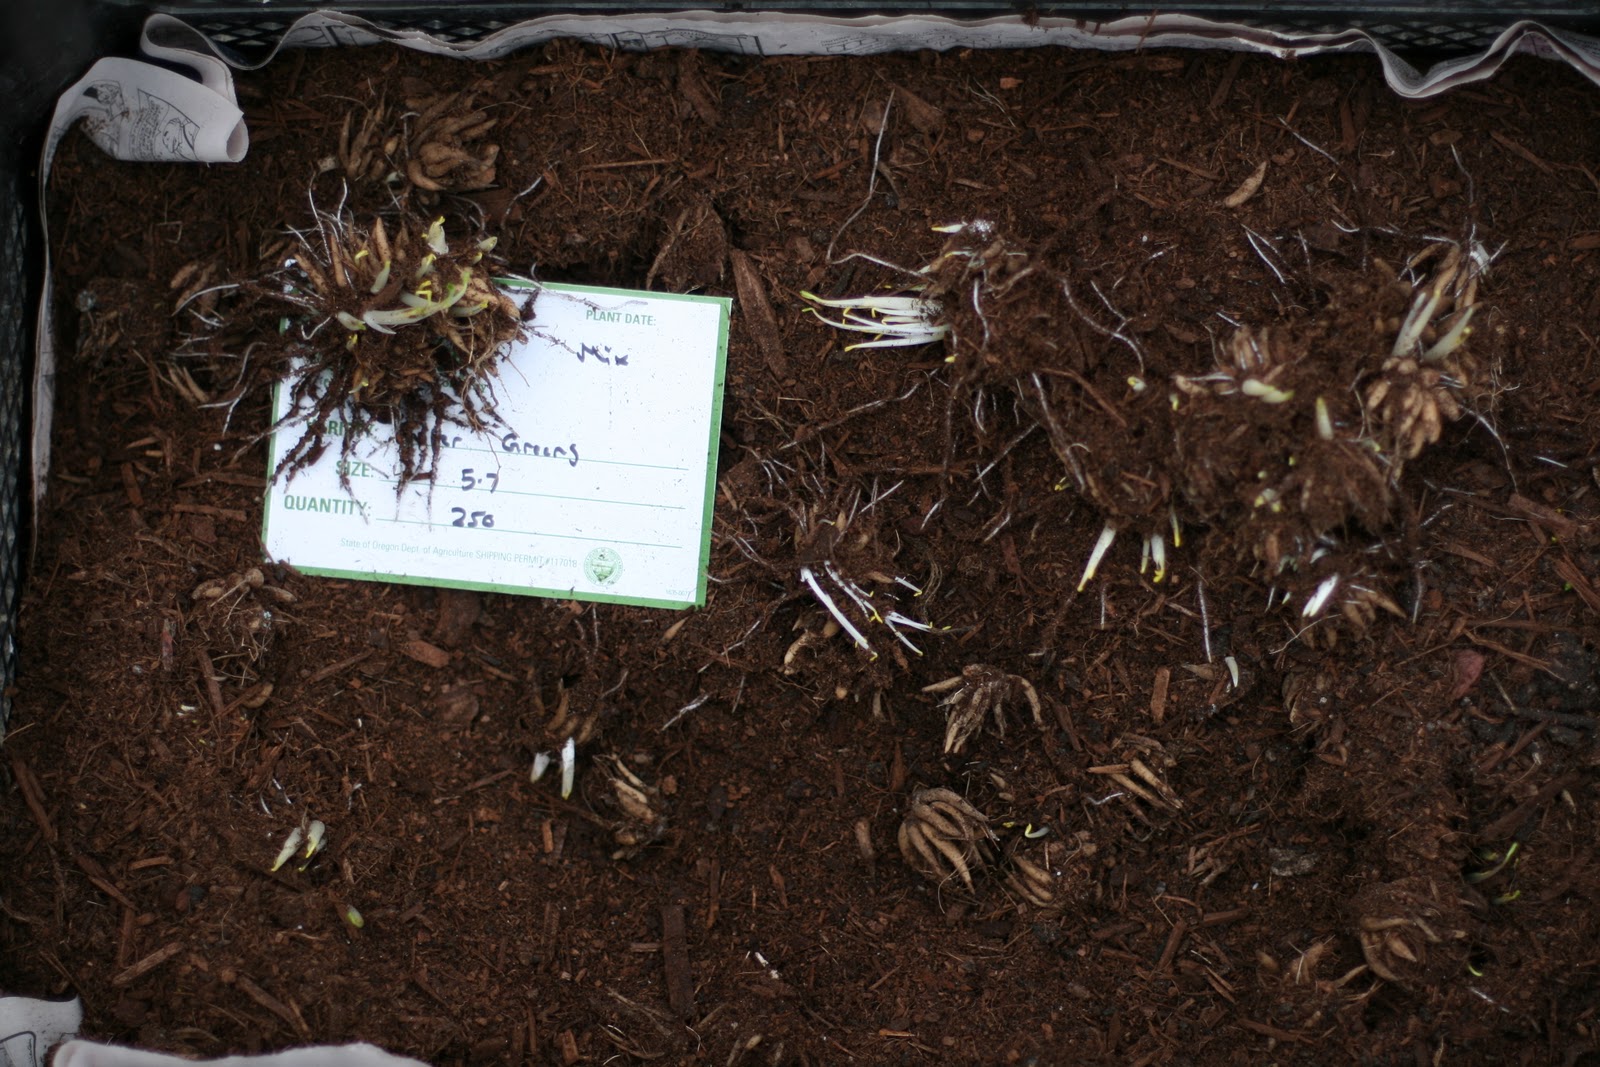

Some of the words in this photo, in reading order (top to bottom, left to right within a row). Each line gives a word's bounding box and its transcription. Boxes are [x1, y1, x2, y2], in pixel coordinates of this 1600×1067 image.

[586, 309, 622, 323] PLANT
[625, 313, 656, 326] DATE:
[451, 506, 495, 528] 250
[340, 537, 361, 548] State
[363, 540, 370, 549] of
[372, 540, 400, 552] Oregon
[423, 545, 431, 554] of
[433, 546, 474, 558] Agriculture
[475, 550, 512, 562] SHIPPING
[514, 553, 544, 565] PERMIT
